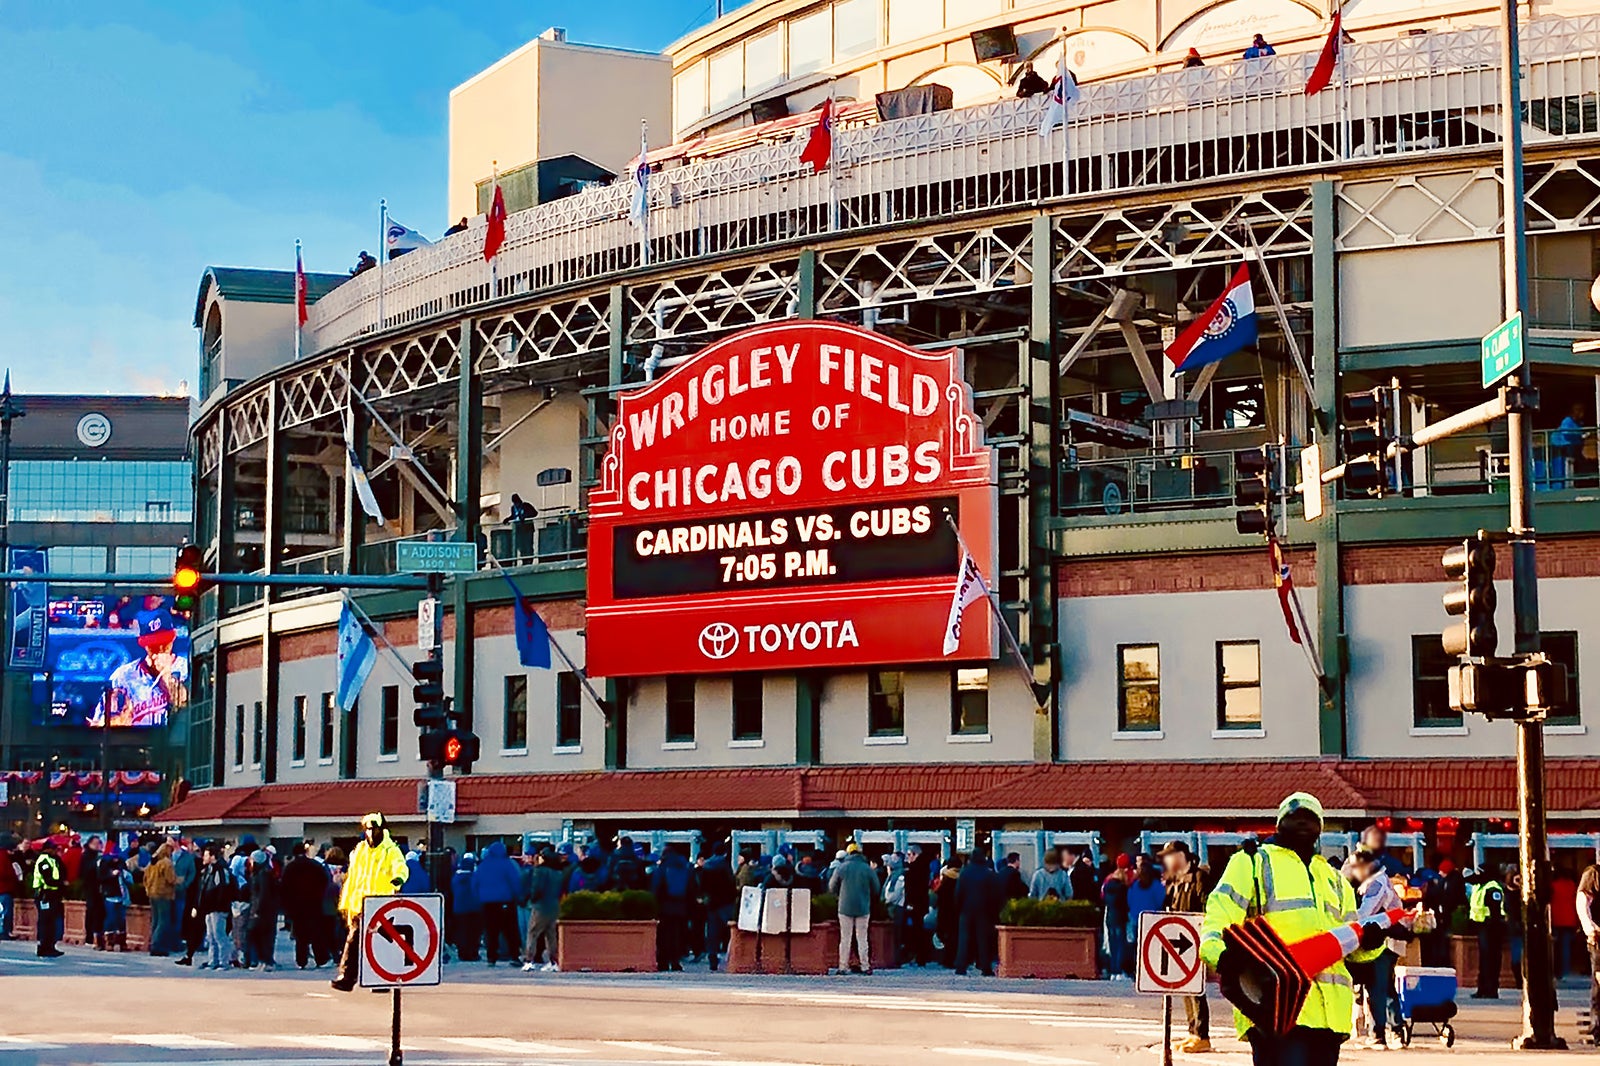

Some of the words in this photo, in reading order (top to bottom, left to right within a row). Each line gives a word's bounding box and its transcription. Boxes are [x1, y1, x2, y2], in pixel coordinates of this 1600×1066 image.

[629, 343, 800, 451] WRIGLEY
[820, 344, 940, 416] FIELD
[710, 410, 791, 443] HOME
[811, 403, 850, 430] OF
[627, 456, 802, 510] CHICAGO
[822, 441, 941, 491] CUBS
[636, 517, 788, 556] CARDINALS
[795, 514, 841, 543] VS.
[850, 505, 931, 538] CUBS
[411, 546, 460, 558] ADDISON
[462, 548, 473, 557] ST
[419, 560, 444, 568] 3600
[449, 560, 456, 568] N
[720, 553, 776, 582] 7:05
[784, 549, 837, 578] P.M.
[31, 612, 44, 647] BRYANT
[743, 620, 859, 653] TOYOTA
